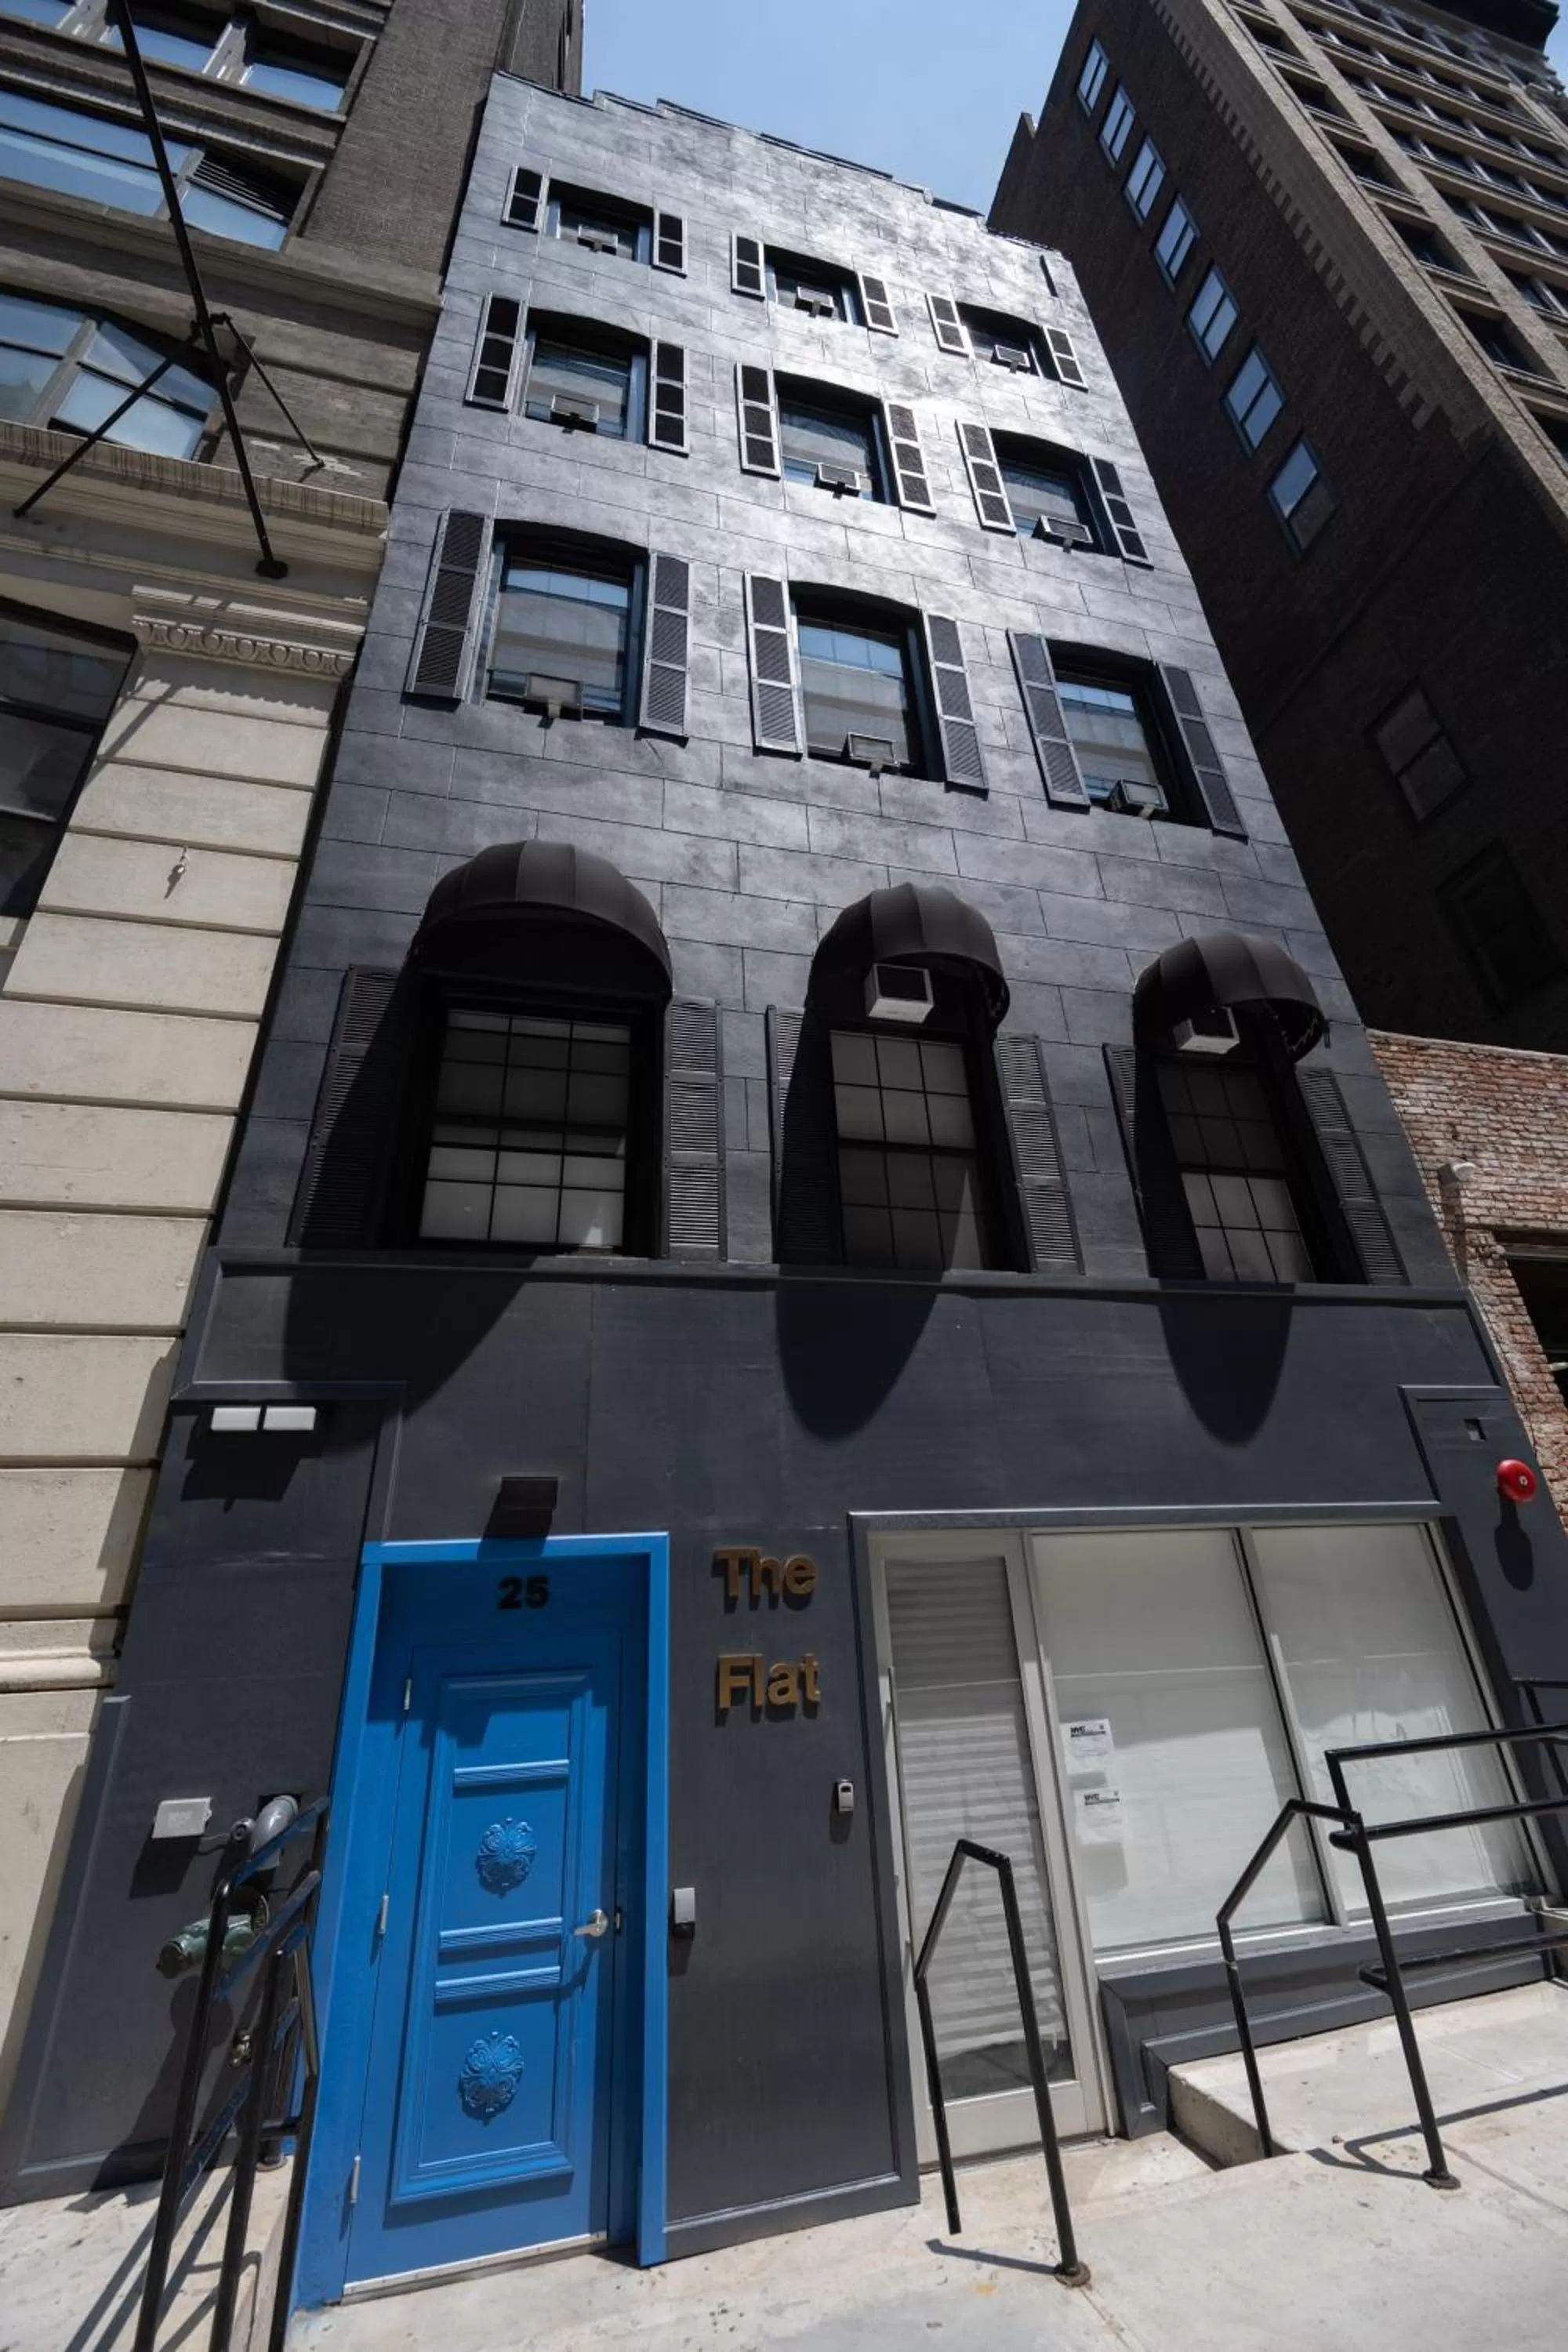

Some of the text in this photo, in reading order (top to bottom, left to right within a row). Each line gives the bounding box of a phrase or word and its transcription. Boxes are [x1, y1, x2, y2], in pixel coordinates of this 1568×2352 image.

[498, 1576, 549, 1610] 25
[712, 1546, 816, 1596] The
[718, 1653, 821, 1708] Flat
